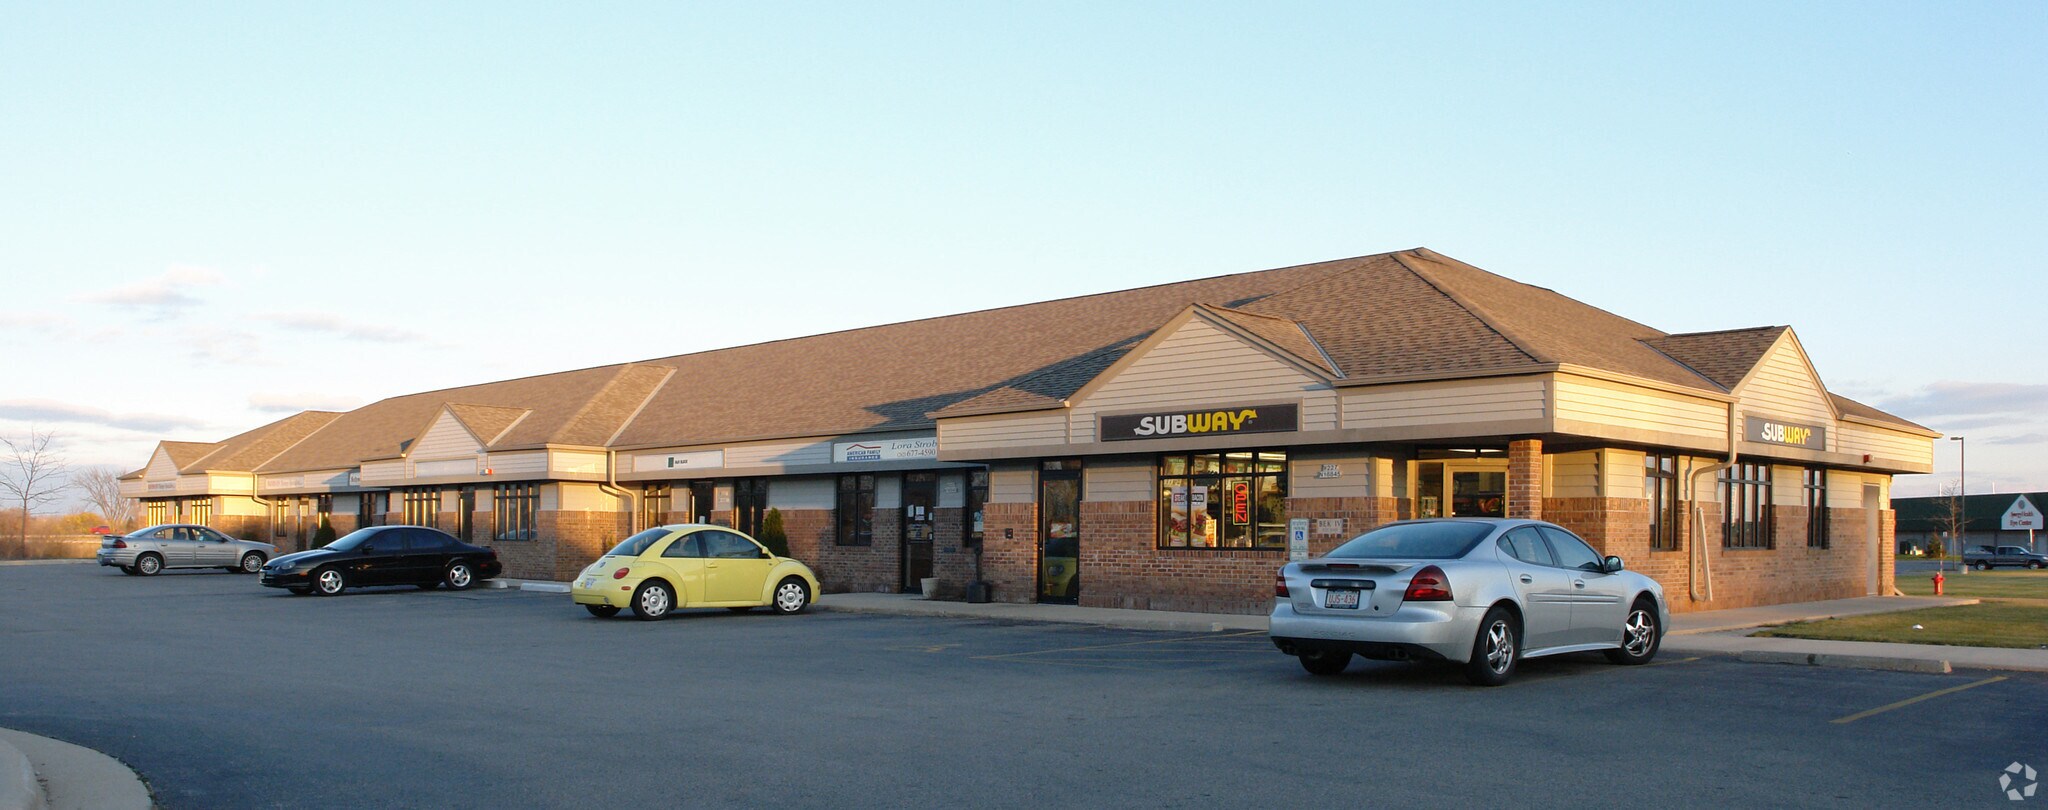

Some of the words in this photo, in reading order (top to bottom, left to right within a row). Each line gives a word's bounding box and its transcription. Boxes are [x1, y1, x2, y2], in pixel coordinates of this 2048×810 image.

[1134, 410, 1257, 436] SUBWAY
[1761, 422, 1811, 445] SUBWAY
[892, 442, 912, 450] Lora
[1235, 484, 1247, 523] OPEN
